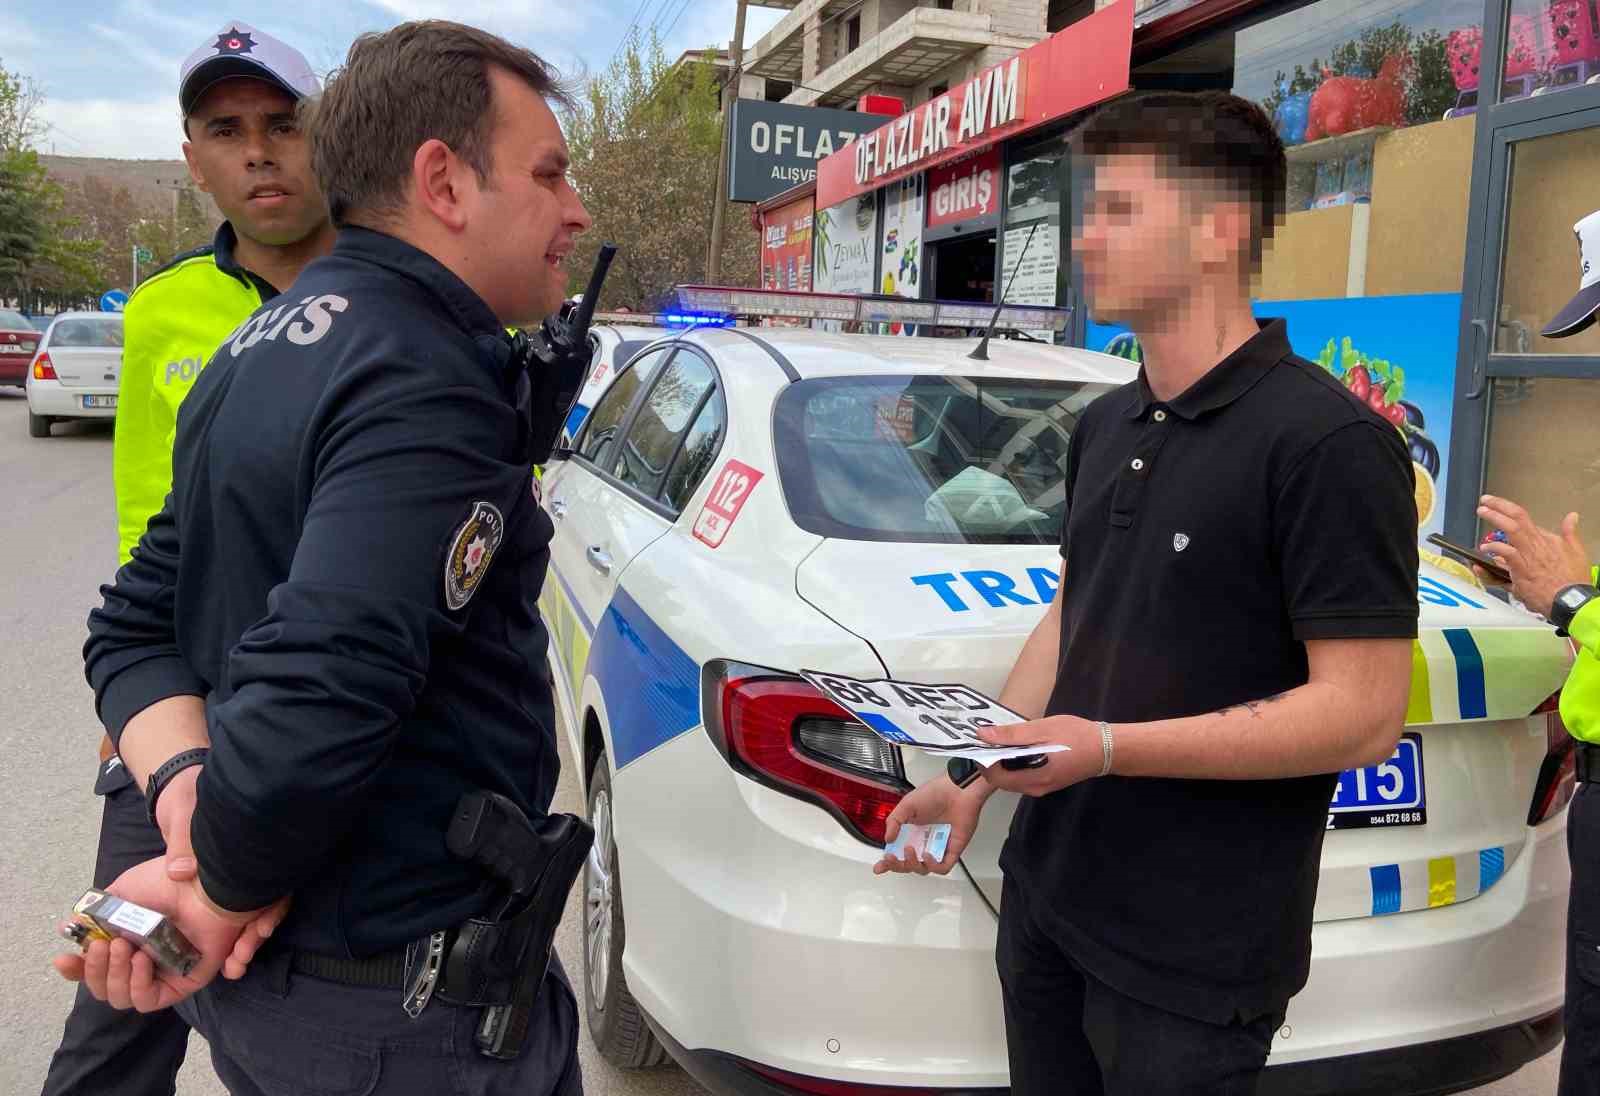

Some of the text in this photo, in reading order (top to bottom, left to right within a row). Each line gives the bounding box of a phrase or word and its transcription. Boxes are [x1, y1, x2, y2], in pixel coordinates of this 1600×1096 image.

[958, 56, 1019, 143] AVM
[935, 165, 992, 217] GİRİŞ
[712, 470, 750, 513] 112
[821, 677, 891, 707] 68
